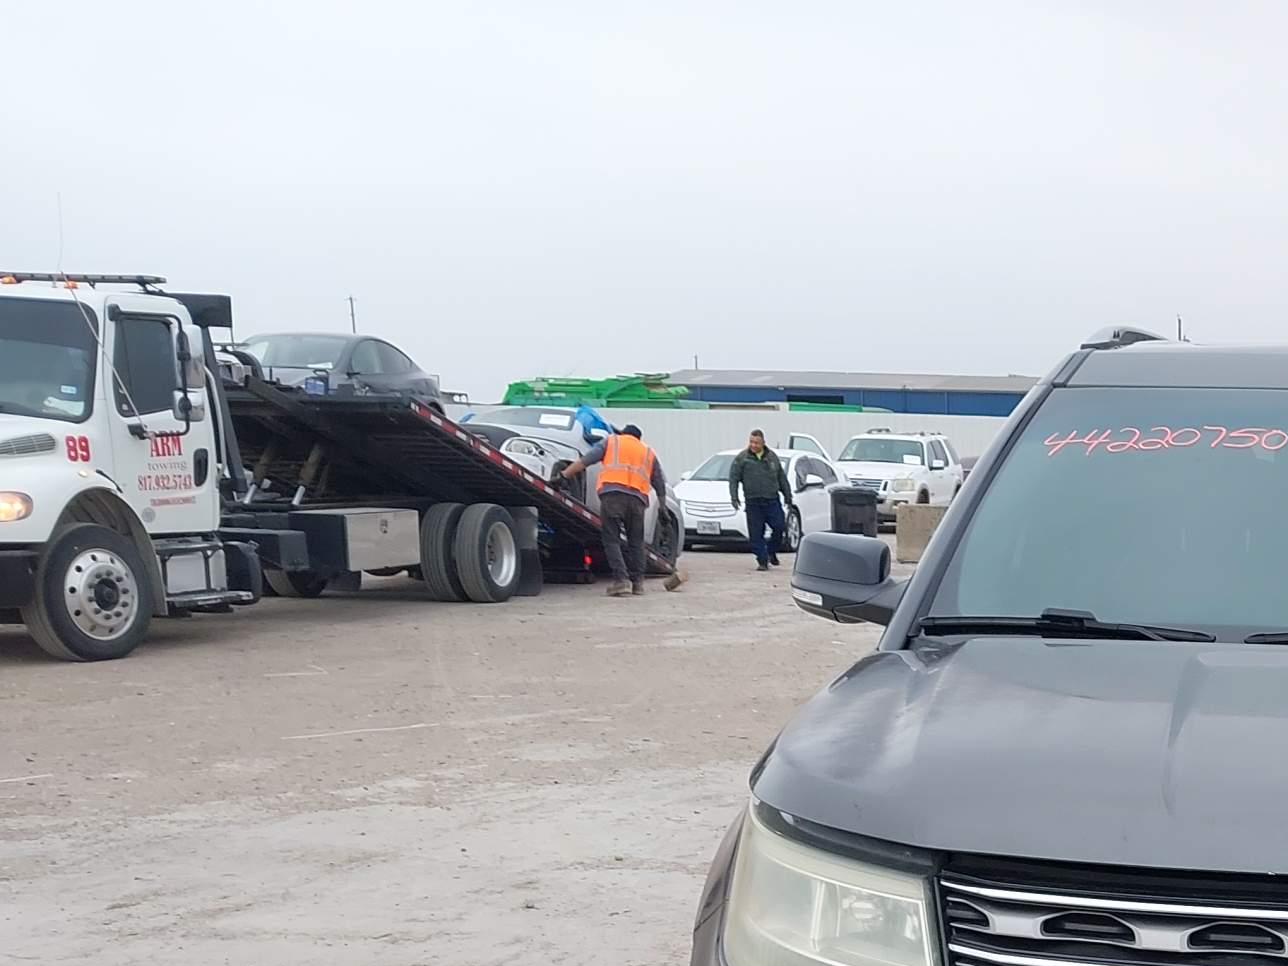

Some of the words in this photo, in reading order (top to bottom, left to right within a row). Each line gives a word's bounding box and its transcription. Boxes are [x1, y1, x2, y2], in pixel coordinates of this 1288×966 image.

[65, 435, 91, 462] 89
[150, 431, 183, 457] ARM
[1044, 426, 1288, 456] 44220750
